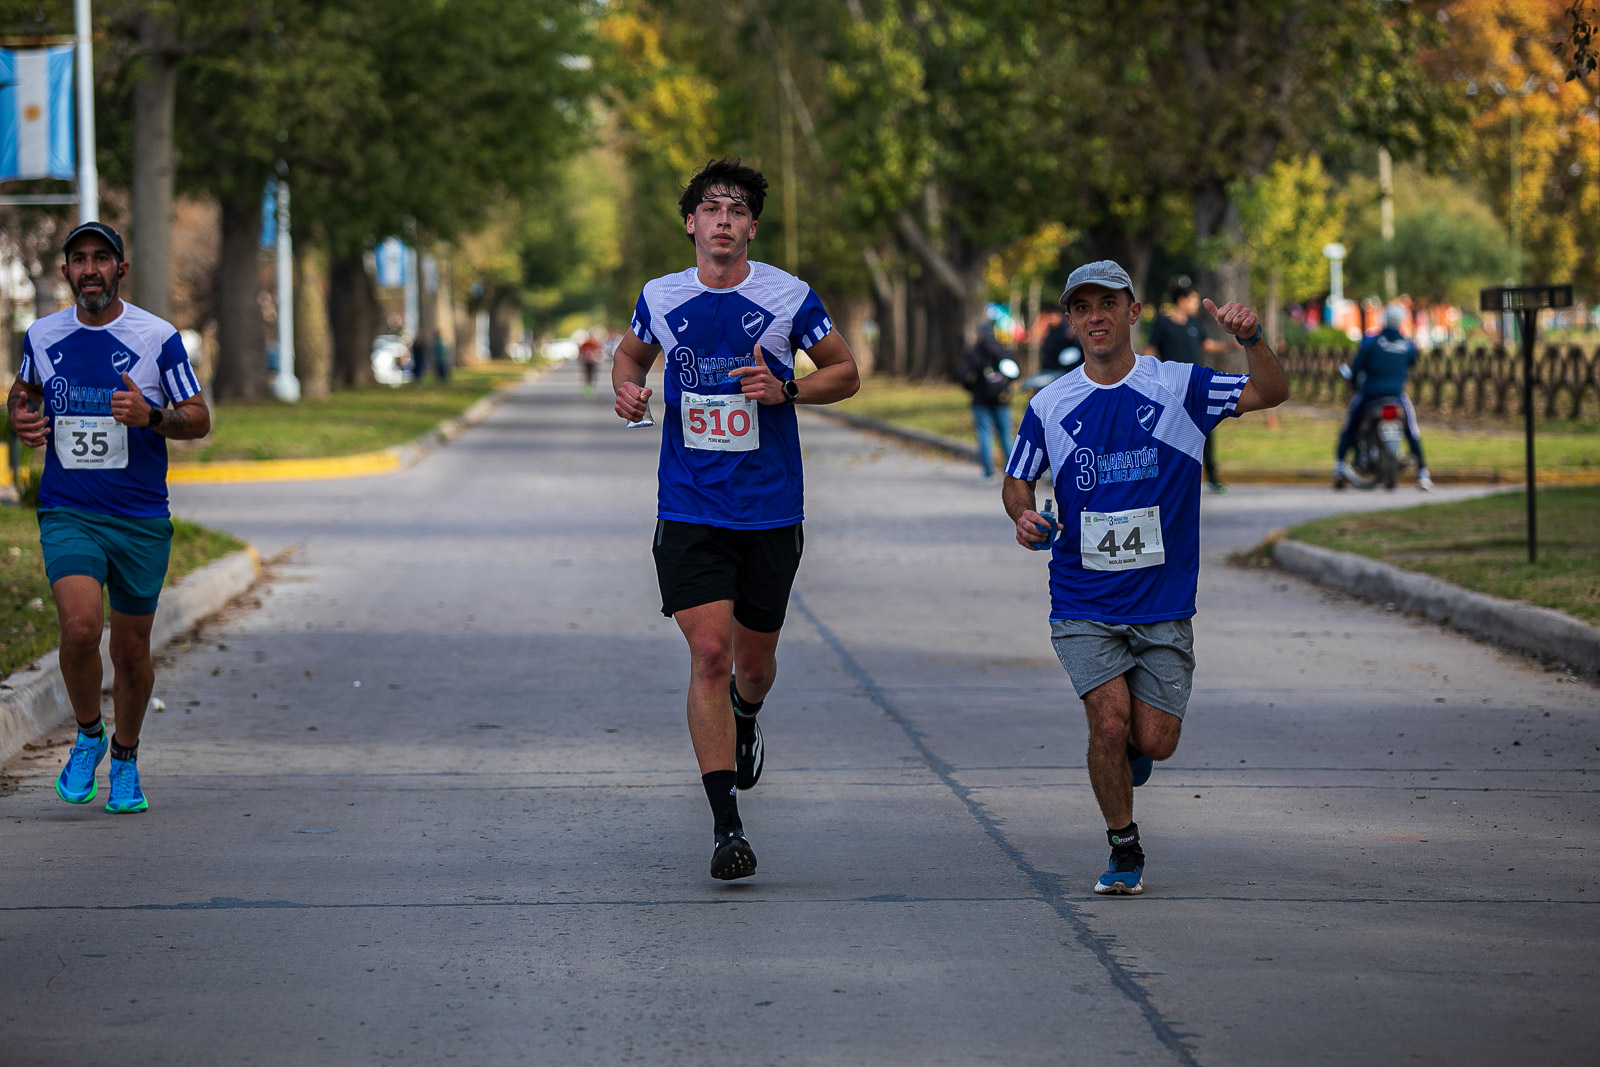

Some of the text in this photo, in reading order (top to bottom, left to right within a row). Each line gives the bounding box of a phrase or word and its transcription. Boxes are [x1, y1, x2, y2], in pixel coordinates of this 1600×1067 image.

[675, 346, 699, 389] 3
[51, 376, 68, 415] 3
[689, 408, 751, 437] 510
[71, 432, 109, 457] 35
[1075, 446, 1158, 491] 3 MARATÓN
[1097, 526, 1146, 557] 44
